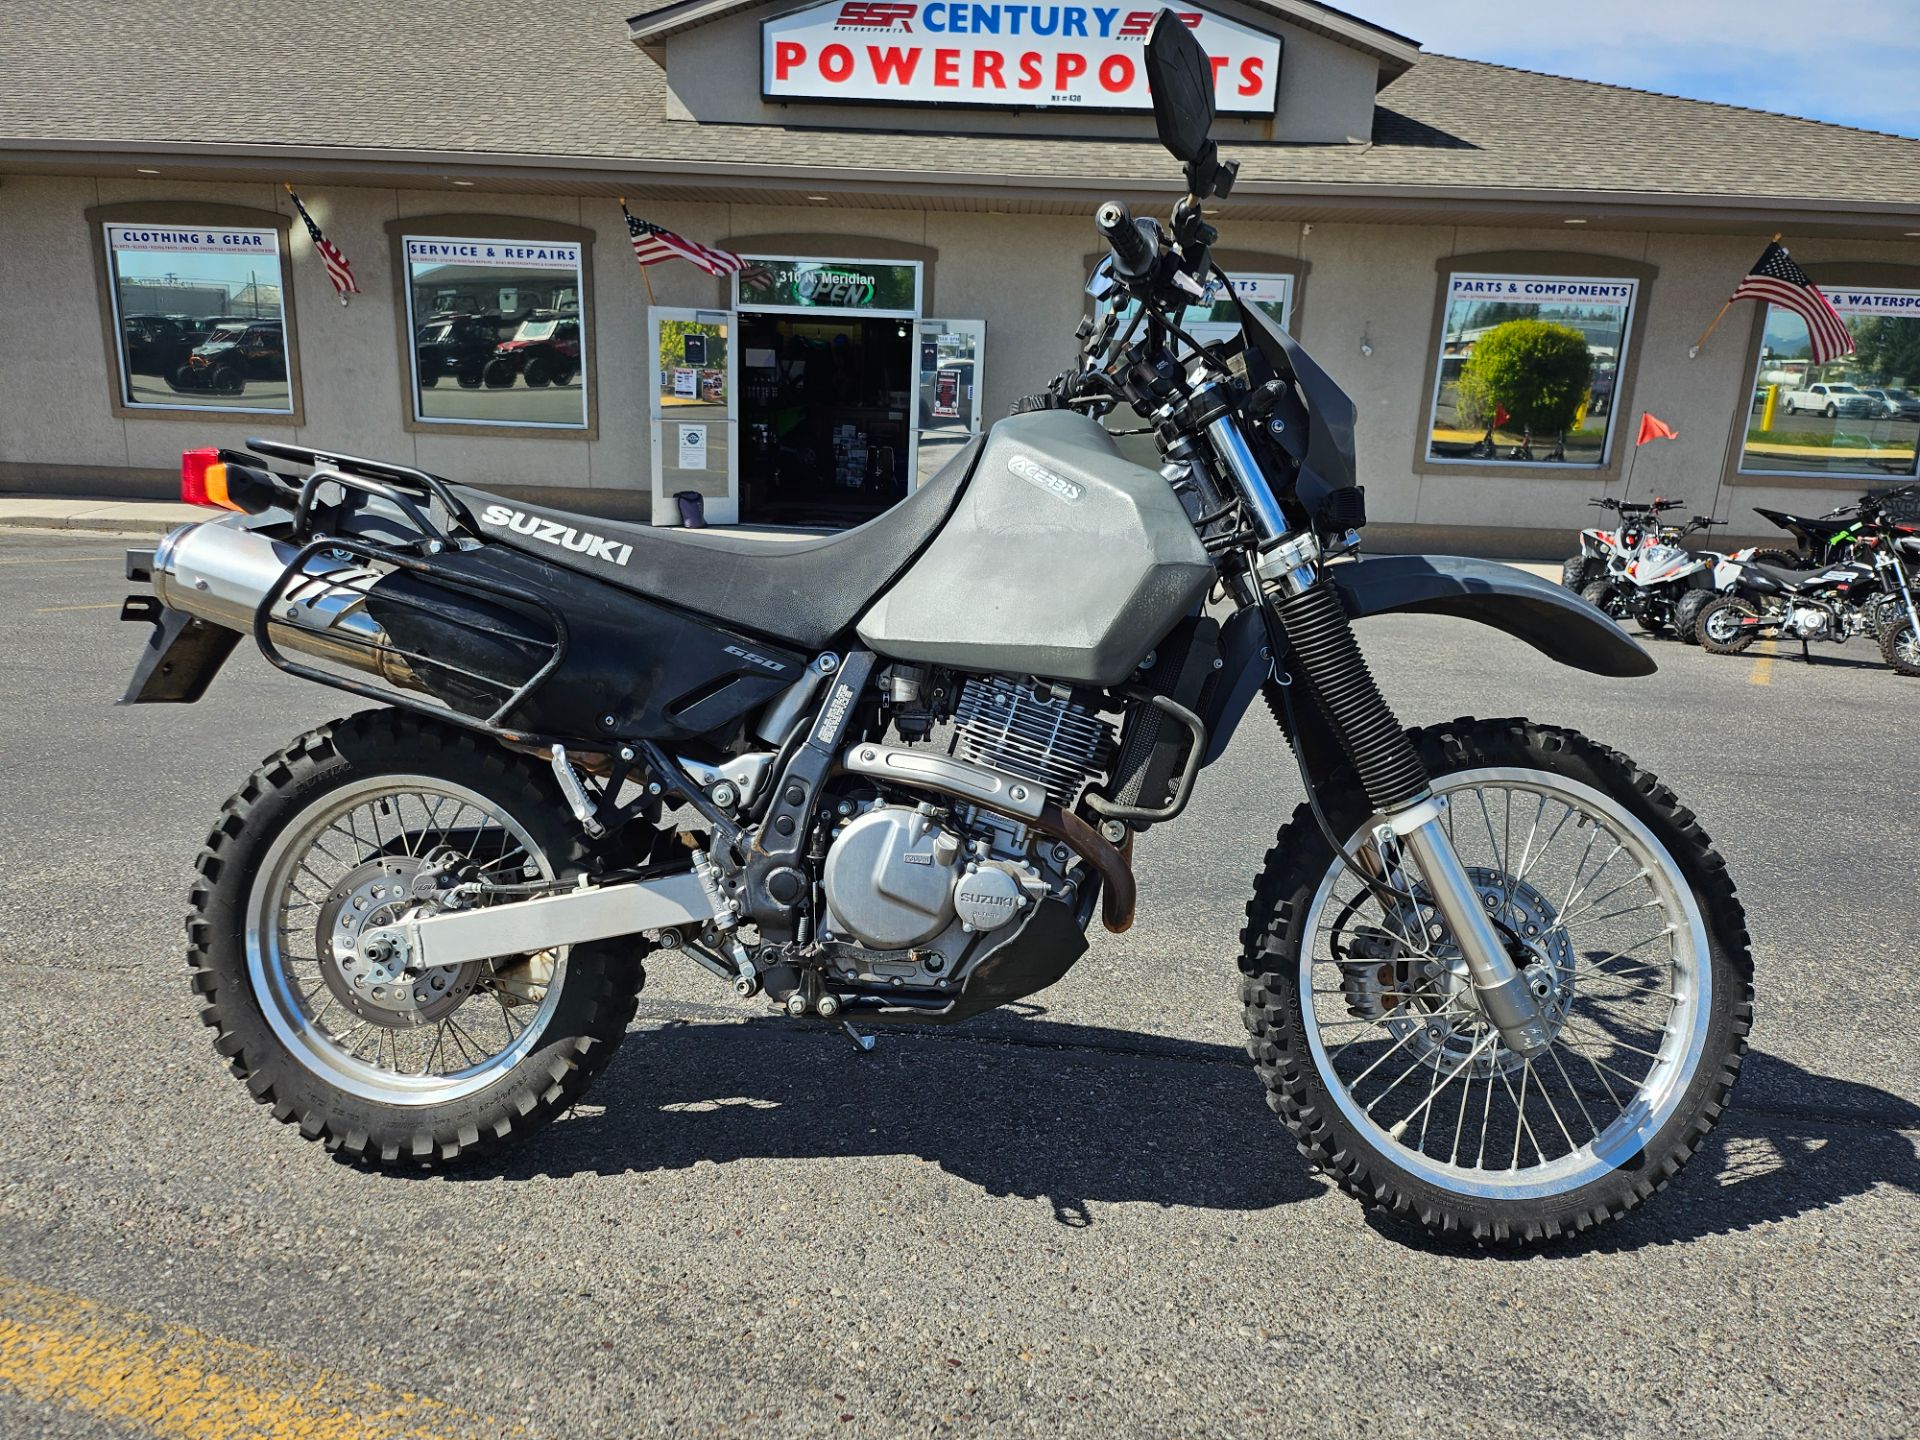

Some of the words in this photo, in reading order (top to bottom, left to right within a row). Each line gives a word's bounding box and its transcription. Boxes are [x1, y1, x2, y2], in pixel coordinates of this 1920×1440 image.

[836, 2, 918, 33] SSR
[922, 3, 1120, 38] CENTURY
[776, 41, 1264, 97] POWERSPOTS
[123, 232, 199, 244] CLOTHING
[207, 234, 215, 244] &
[223, 235, 262, 245] GEAR
[411, 244, 478, 256] SERVICE
[486, 248, 495, 257] &
[505, 248, 575, 260] REPAIRS
[798, 272, 866, 305] OPEN
[821, 273, 875, 285] Meridian
[1453, 281, 1502, 292] PARTS
[1508, 283, 1517, 293] &
[1525, 283, 1628, 297] COMPONENTS
[1833, 295, 1842, 304] &
[1010, 460, 1081, 499] ACERBIS
[481, 505, 634, 566] SUZUKI
[723, 645, 787, 672] 650
[960, 892, 1013, 908] SUZUKI
